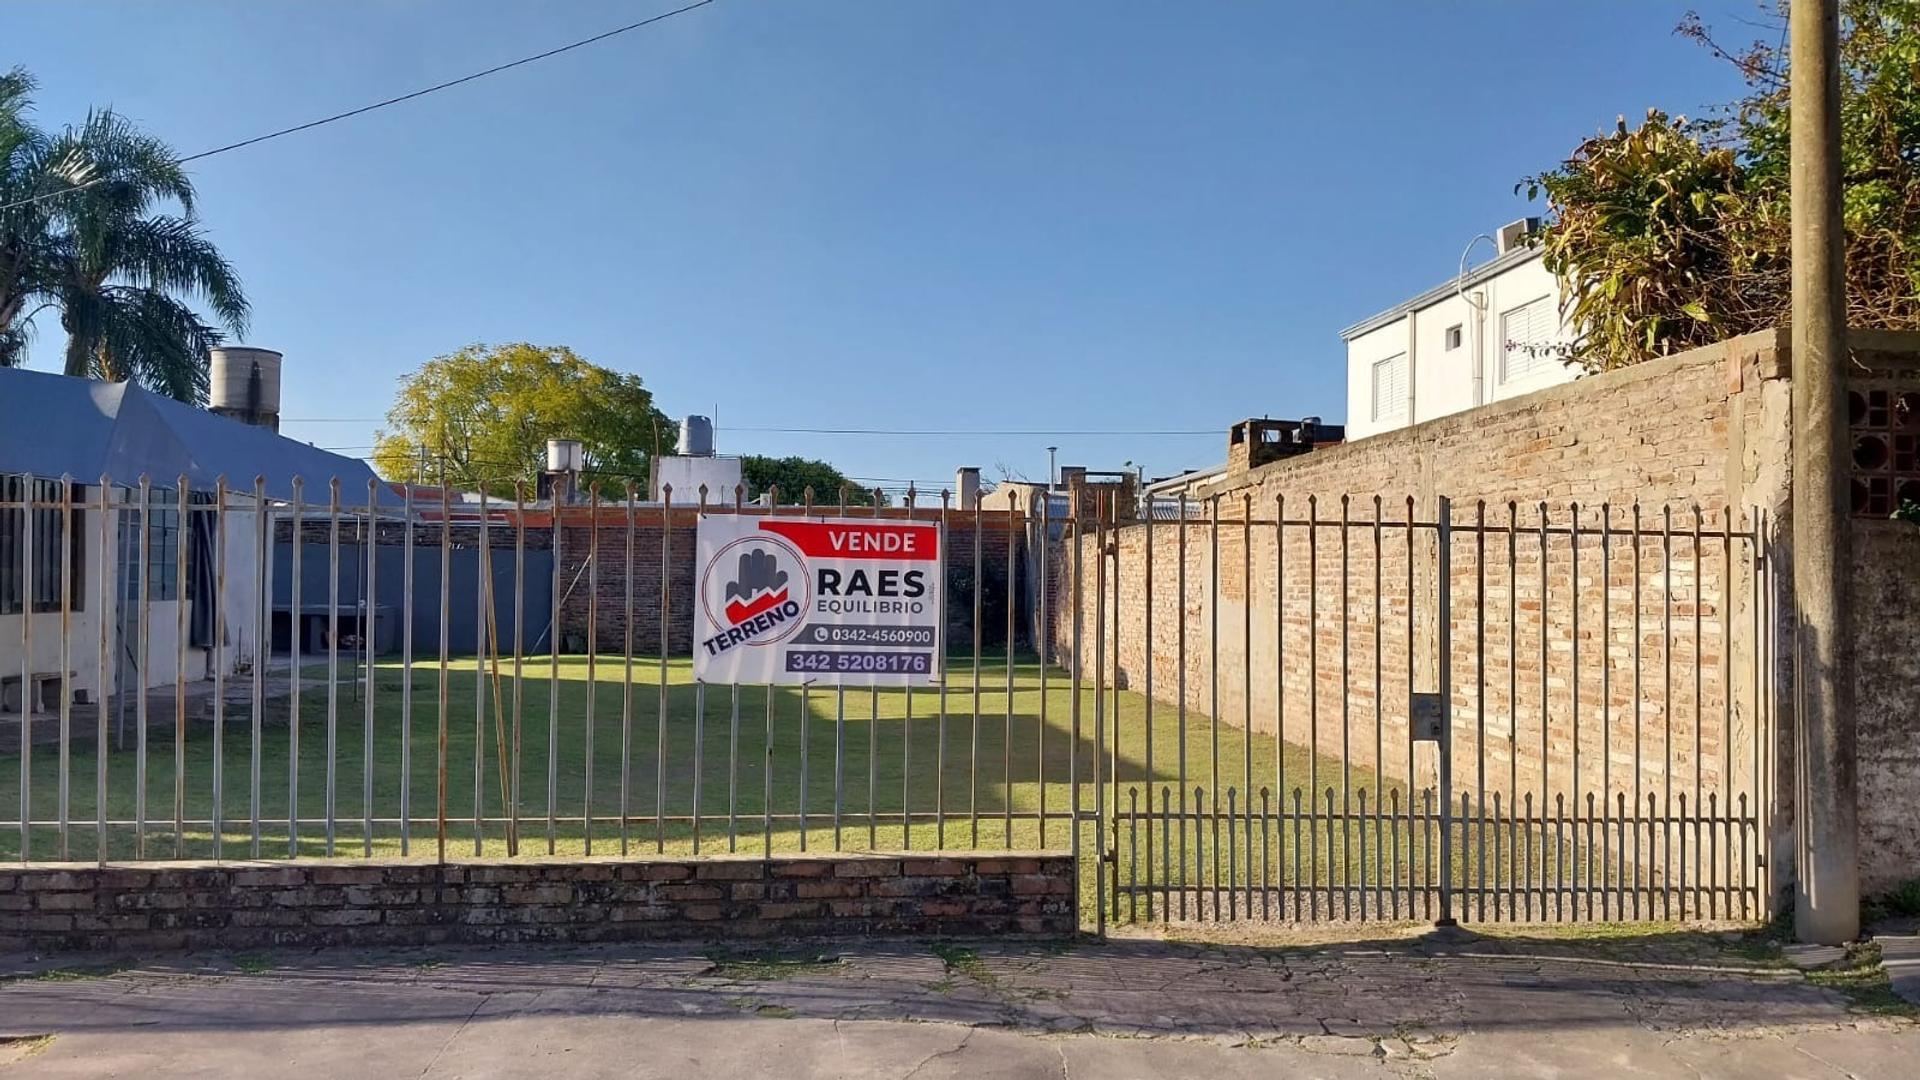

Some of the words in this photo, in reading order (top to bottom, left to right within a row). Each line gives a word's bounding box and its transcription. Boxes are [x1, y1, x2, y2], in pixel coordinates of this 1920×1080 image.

[829, 530, 916, 552] VENDE
[817, 568, 925, 598] RAES
[817, 599, 924, 615] EQUILIBRIO
[703, 600, 800, 656] TERRENO
[832, 628, 931, 643] 0342-4560900
[792, 654, 831, 670] 342
[837, 655, 926, 671] 5208176
